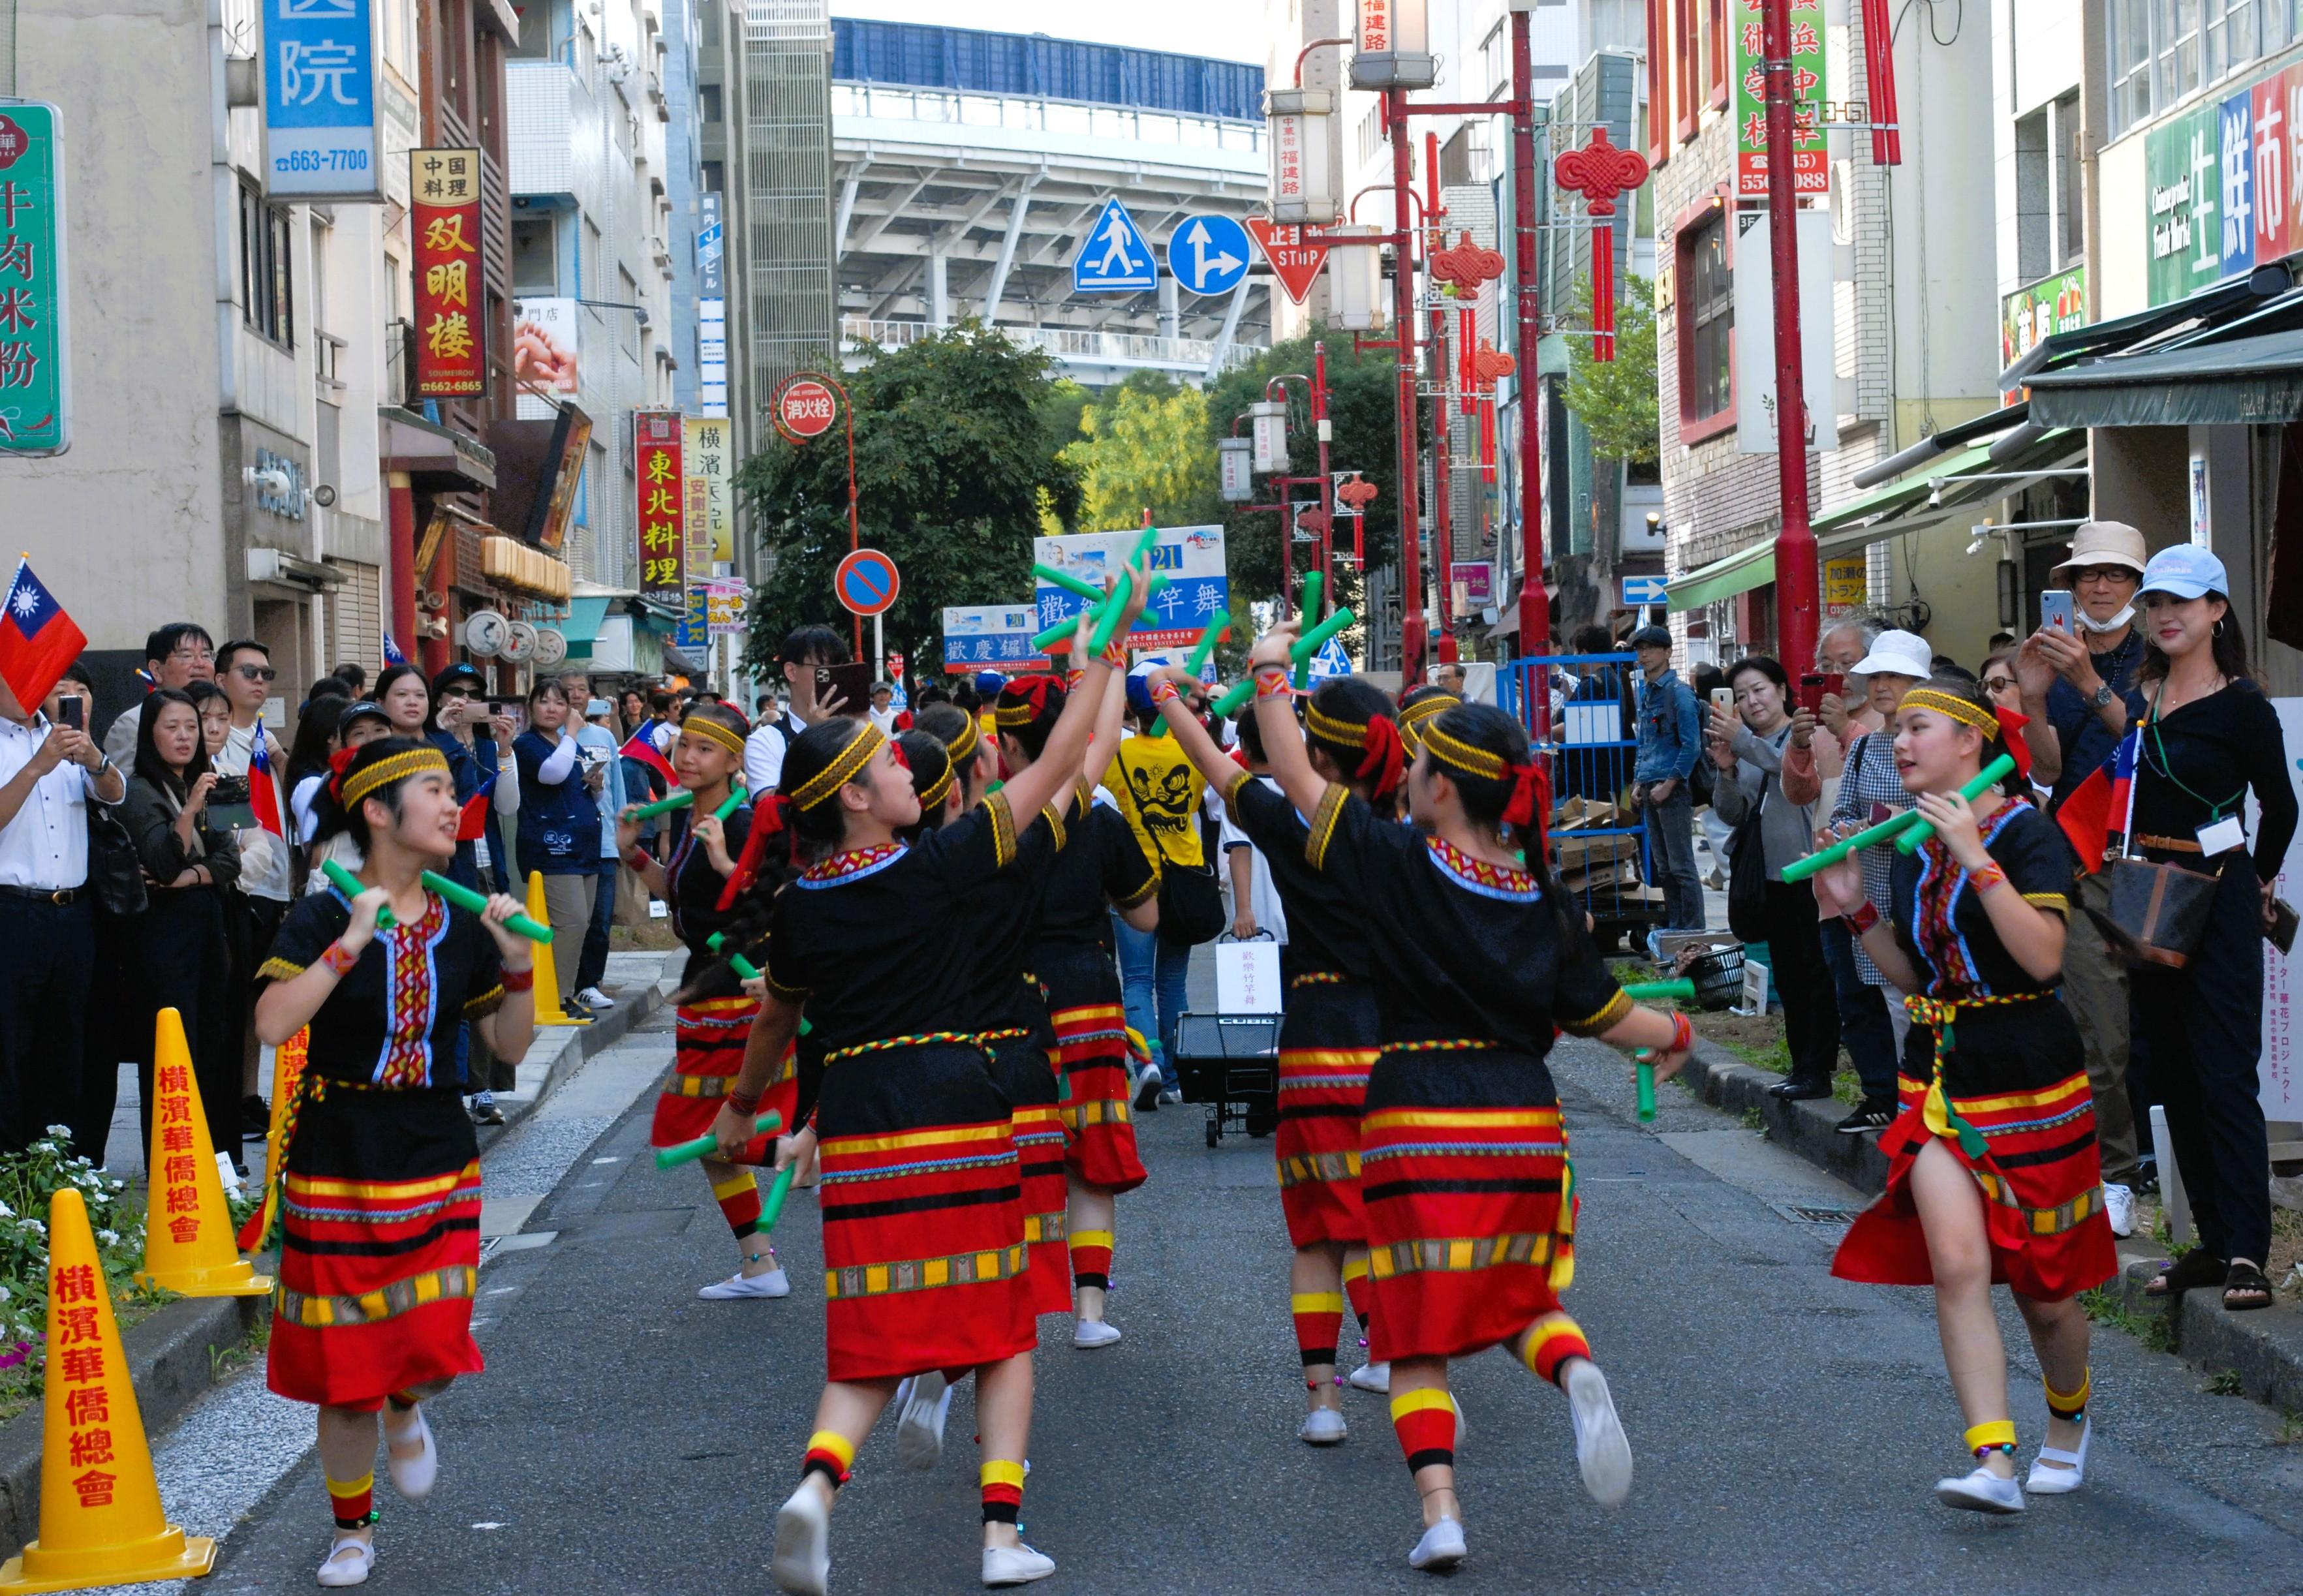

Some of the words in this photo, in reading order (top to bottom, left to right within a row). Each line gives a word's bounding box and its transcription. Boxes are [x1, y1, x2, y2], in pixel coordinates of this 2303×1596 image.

[279, 0, 358, 106] 院
[291, 149, 367, 172] 663-7700
[423, 156, 467, 176] 中国
[424, 178, 469, 198] 料理
[1740, 217, 1755, 228] 3F
[424, 213, 476, 360] 双明楼
[431, 380, 482, 391] 662-6865
[786, 397, 831, 420] 消火栓
[643, 450, 681, 585] 東北料理
[1153, 546, 1177, 570] 21
[1040, 583, 1224, 627] 歡竿舞
[688, 594, 705, 643] BAR
[1011, 615, 1023, 627] 20
